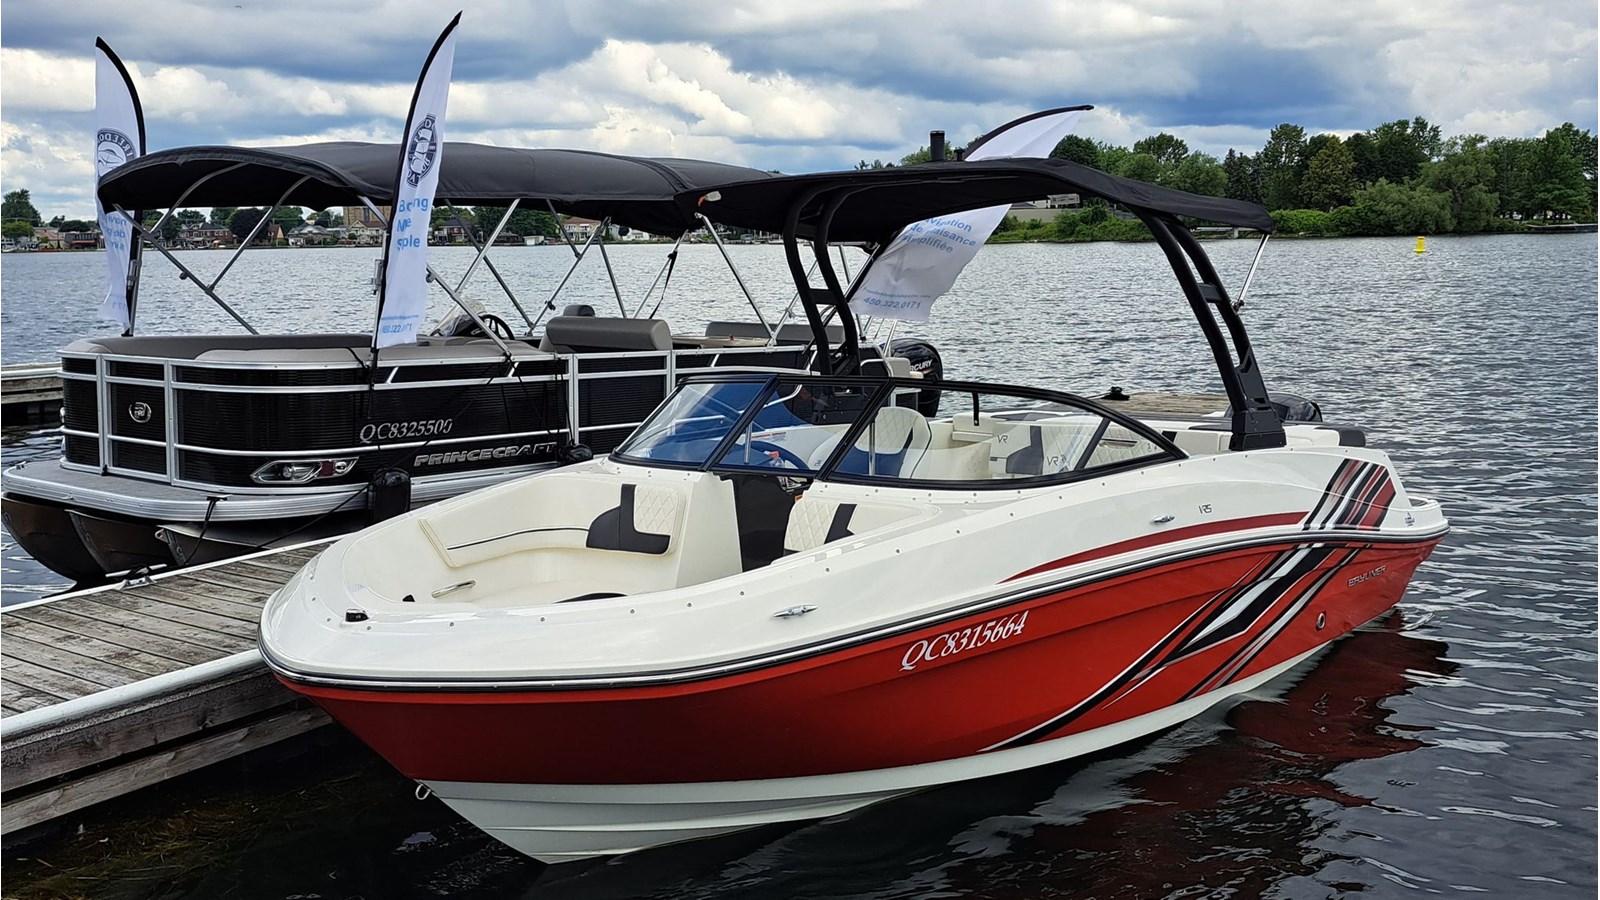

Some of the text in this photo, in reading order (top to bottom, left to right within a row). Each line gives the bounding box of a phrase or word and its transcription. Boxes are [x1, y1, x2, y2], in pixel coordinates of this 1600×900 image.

[909, 359, 933, 371] RCURY
[413, 441, 558, 467] PRINCECRAFT
[898, 610, 1030, 672] QC8315664
